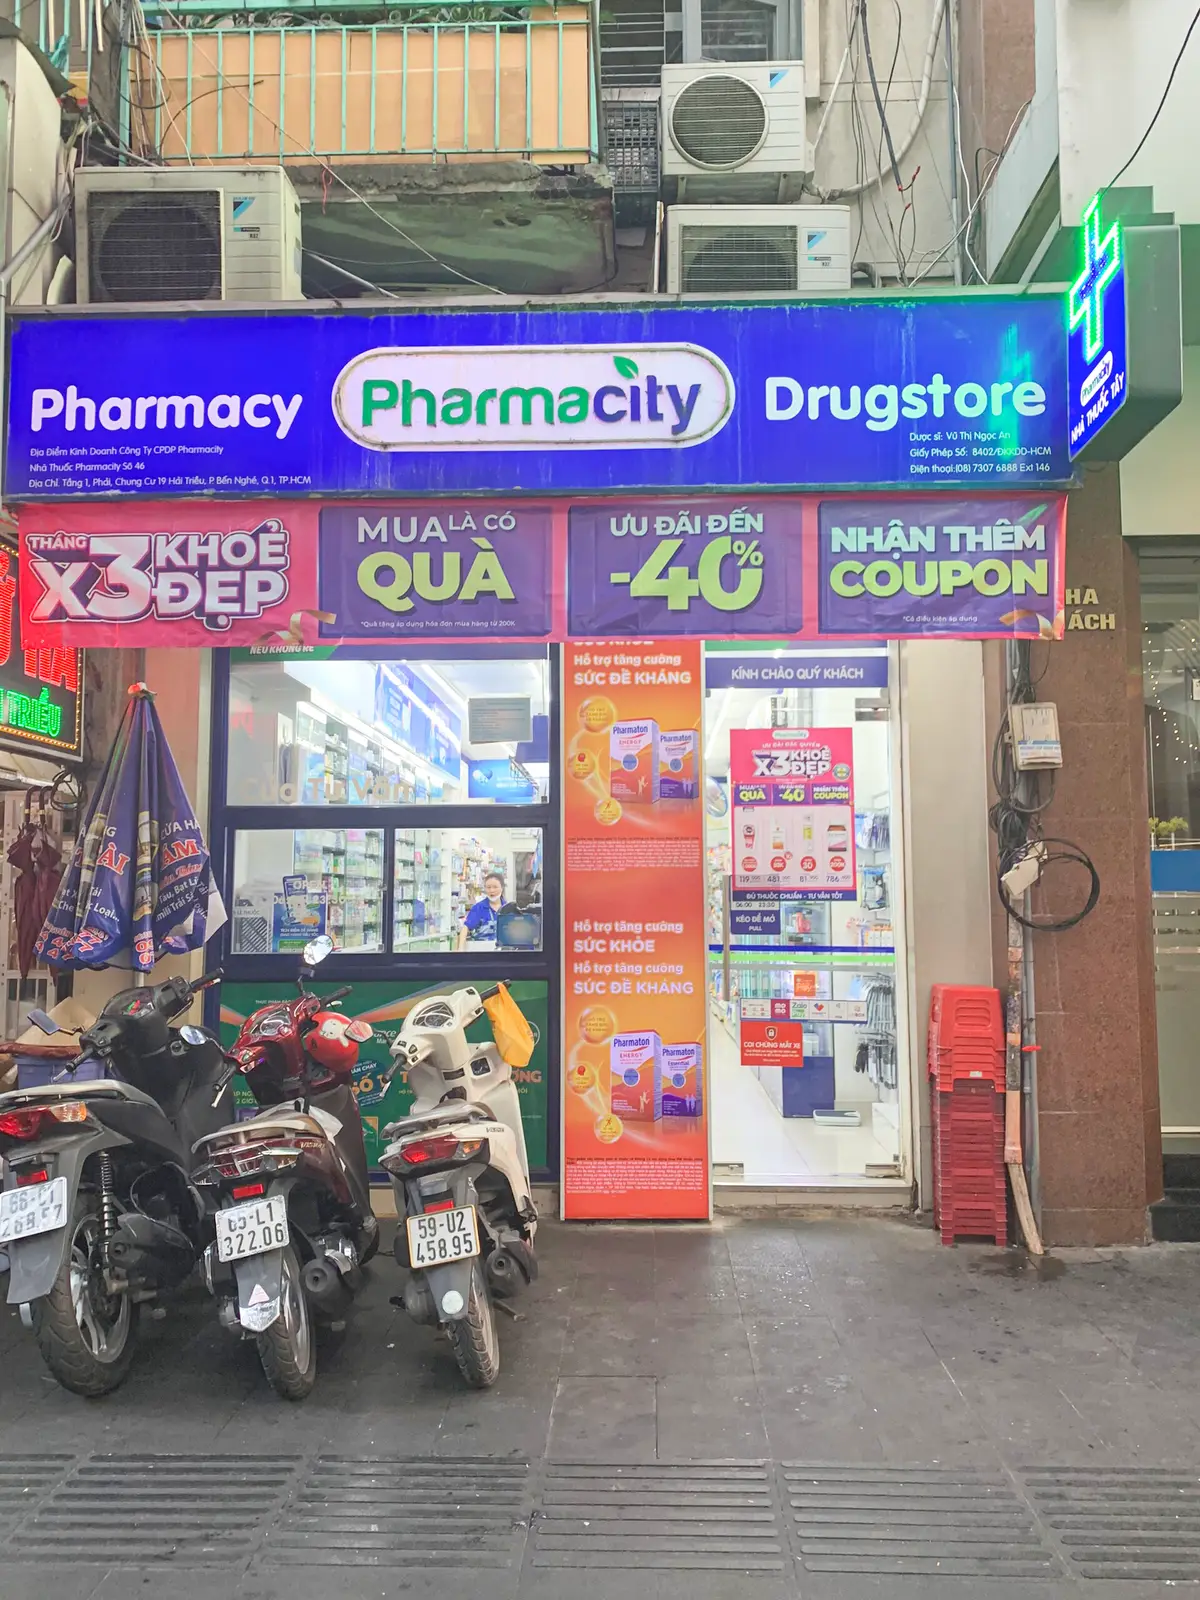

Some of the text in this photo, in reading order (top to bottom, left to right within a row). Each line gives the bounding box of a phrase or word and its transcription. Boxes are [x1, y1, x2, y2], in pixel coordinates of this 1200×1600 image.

[362, 370, 702, 436] Pharmacity
[765, 373, 1047, 432] Drugstore
[31, 385, 302, 440] Pharmacy
[909, 432, 931, 442] Dược
[946, 431, 957, 441] Vũ
[974, 431, 996, 442] Ngọc
[70, 447, 88, 456] Kinh
[89, 446, 117, 456] Doanh
[119, 446, 141, 456] Công
[143, 446, 152, 456] Ty
[153, 445, 177, 454] CPDP
[177, 445, 224, 455] Pharmacity
[931, 447, 953, 459] Phép
[49, 462, 73, 471] Thuốc
[75, 462, 121, 472] Pharmacity
[134, 462, 145, 470] 46
[973, 463, 994, 472] 7307
[996, 463, 1018, 472] 6888
[1020, 463, 1033, 472] Ext
[1035, 462, 1050, 472] 146
[115, 477, 142, 488] Chung
[158, 477, 166, 485] 19
[279, 475, 311, 485] TP.HCM
[358, 510, 516, 543] MUA LÀ CÓ
[610, 506, 764, 537] ƯU ĐÃI ĐẾN
[29, 531, 88, 550] THÁNG
[831, 518, 1046, 560] NHẬN THÊM
[357, 537, 516, 612] QUÀ
[829, 559, 1048, 598] COUPON
[151, 570, 286, 626] ĐẸP
[1066, 588, 1099, 605] HA
[1067, 610, 1116, 630] ÁCH
[574, 652, 592, 666] Hỗ
[593, 655, 611, 667] trợ
[613, 653, 641, 667] tăng
[574, 667, 692, 686] SỨC ĐỀ KHÁNG
[731, 665, 864, 680] KÍNH CHÀO QUÝ KHÁCH
[612, 724, 649, 735] Pharmaton
[660, 734, 692, 743] Pharmaton
[739, 788, 766, 802] QUÀ
[573, 919, 592, 933] Hỗ
[593, 921, 612, 934] trợ
[614, 920, 642, 933] tăng
[573, 935, 656, 953] SỨC KHỎE
[573, 960, 592, 974] Hỗ
[593, 963, 612, 975] trợ
[614, 962, 642, 974] tăng
[573, 977, 694, 994] SỨC ĐỀ KHÁNG
[613, 1037, 650, 1048] Pharmaton
[662, 1048, 695, 1056] Pharmaton
[417, 1211, 466, 1239] 59-U2
[223, 1222, 284, 1257] 322.06
[416, 1233, 473, 1264] 458.95
